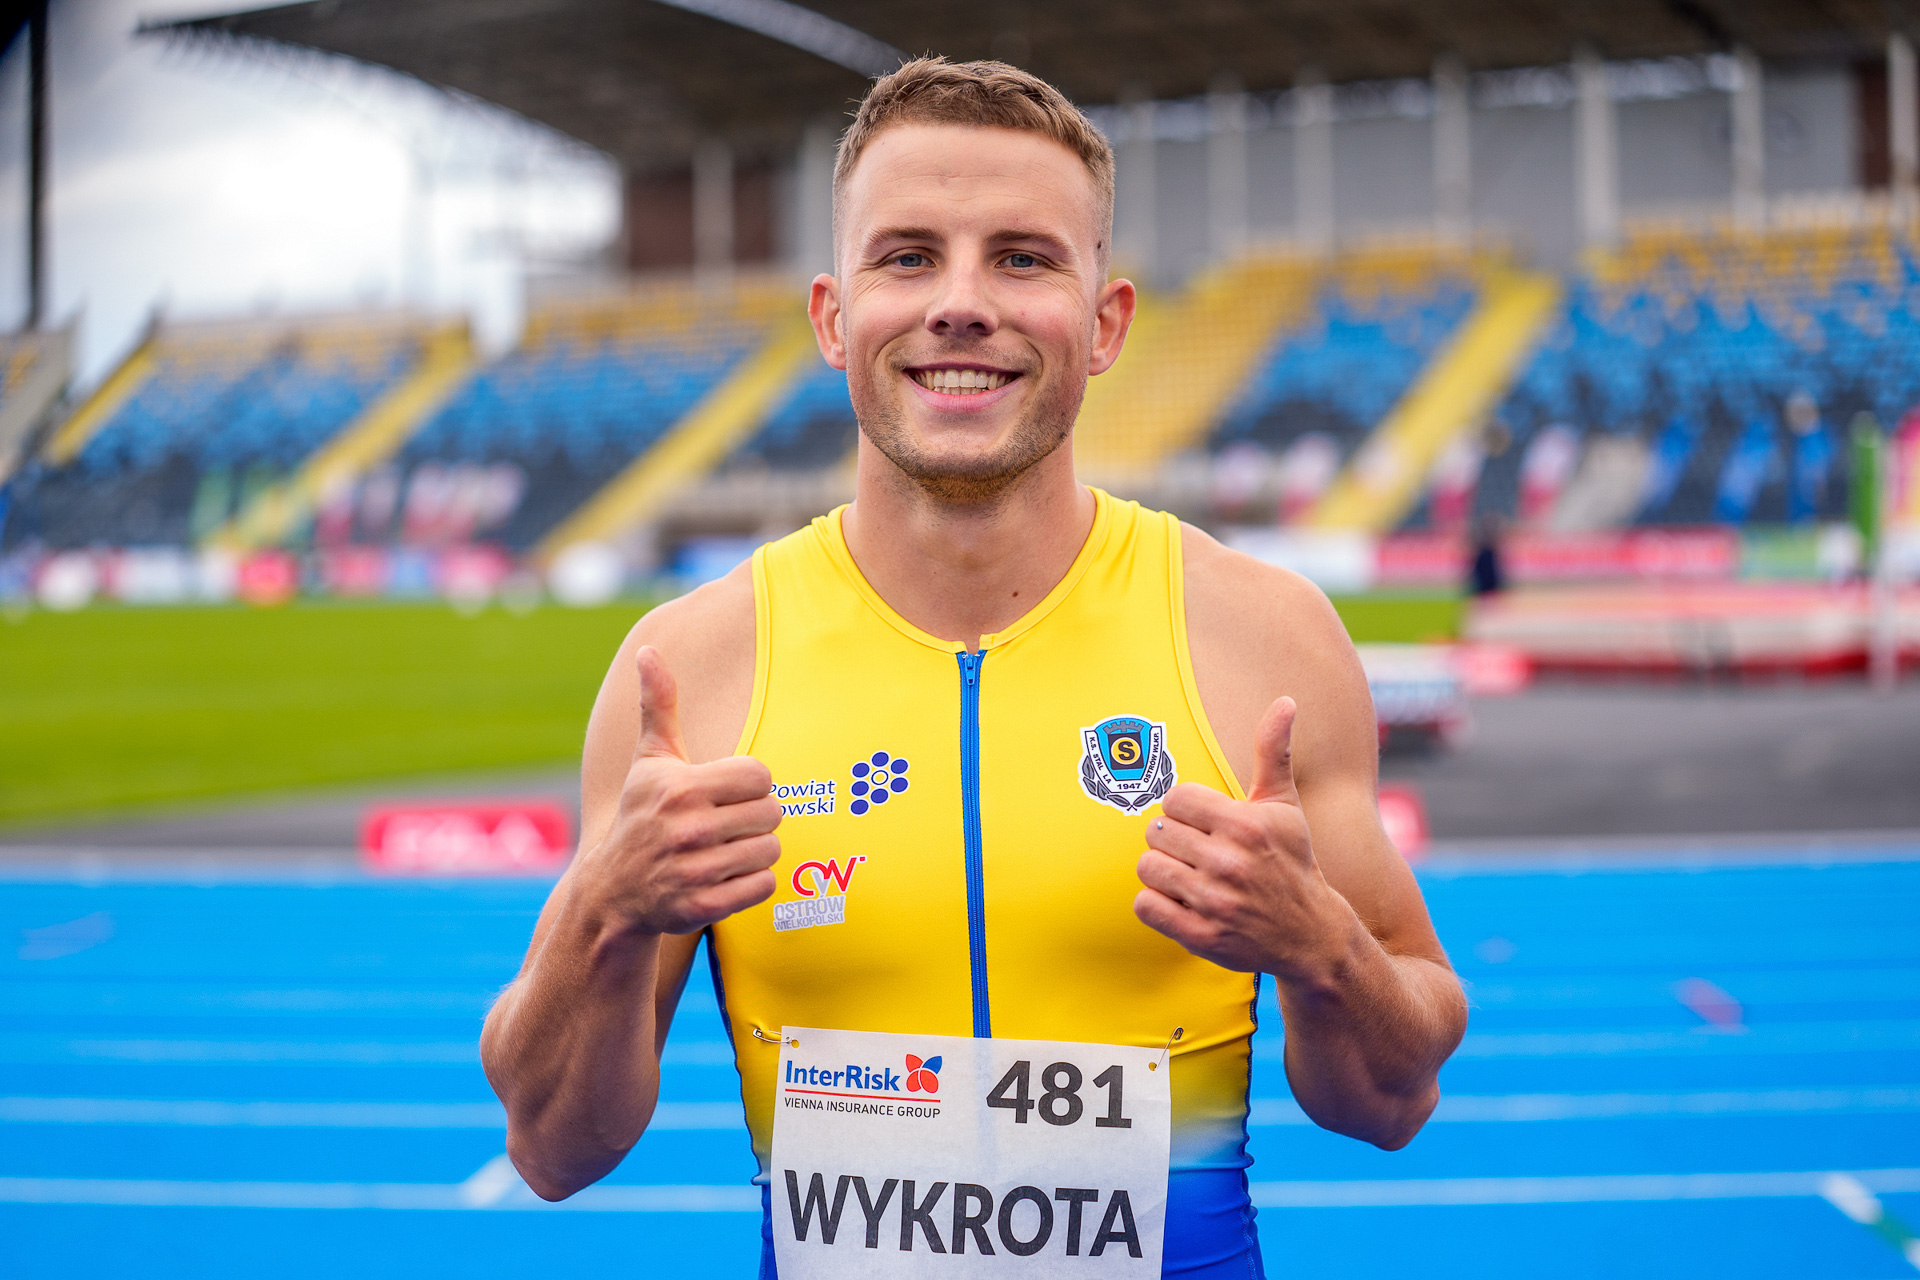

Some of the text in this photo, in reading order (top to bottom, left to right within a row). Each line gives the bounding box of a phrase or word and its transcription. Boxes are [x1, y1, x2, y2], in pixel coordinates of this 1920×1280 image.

[1118, 741, 1135, 761] S
[1093, 753, 1104, 771] STAL
[1102, 773, 1112, 784] LA
[774, 894, 844, 921] OSTRÓW
[774, 912, 844, 930] WIELKOPOLSKI
[785, 1060, 901, 1092] InterRisk
[784, 1097, 941, 1119] VIENNA INSURANCE GROUP
[986, 1060, 1132, 1128] 481
[784, 1169, 1143, 1258] WYKROTA
